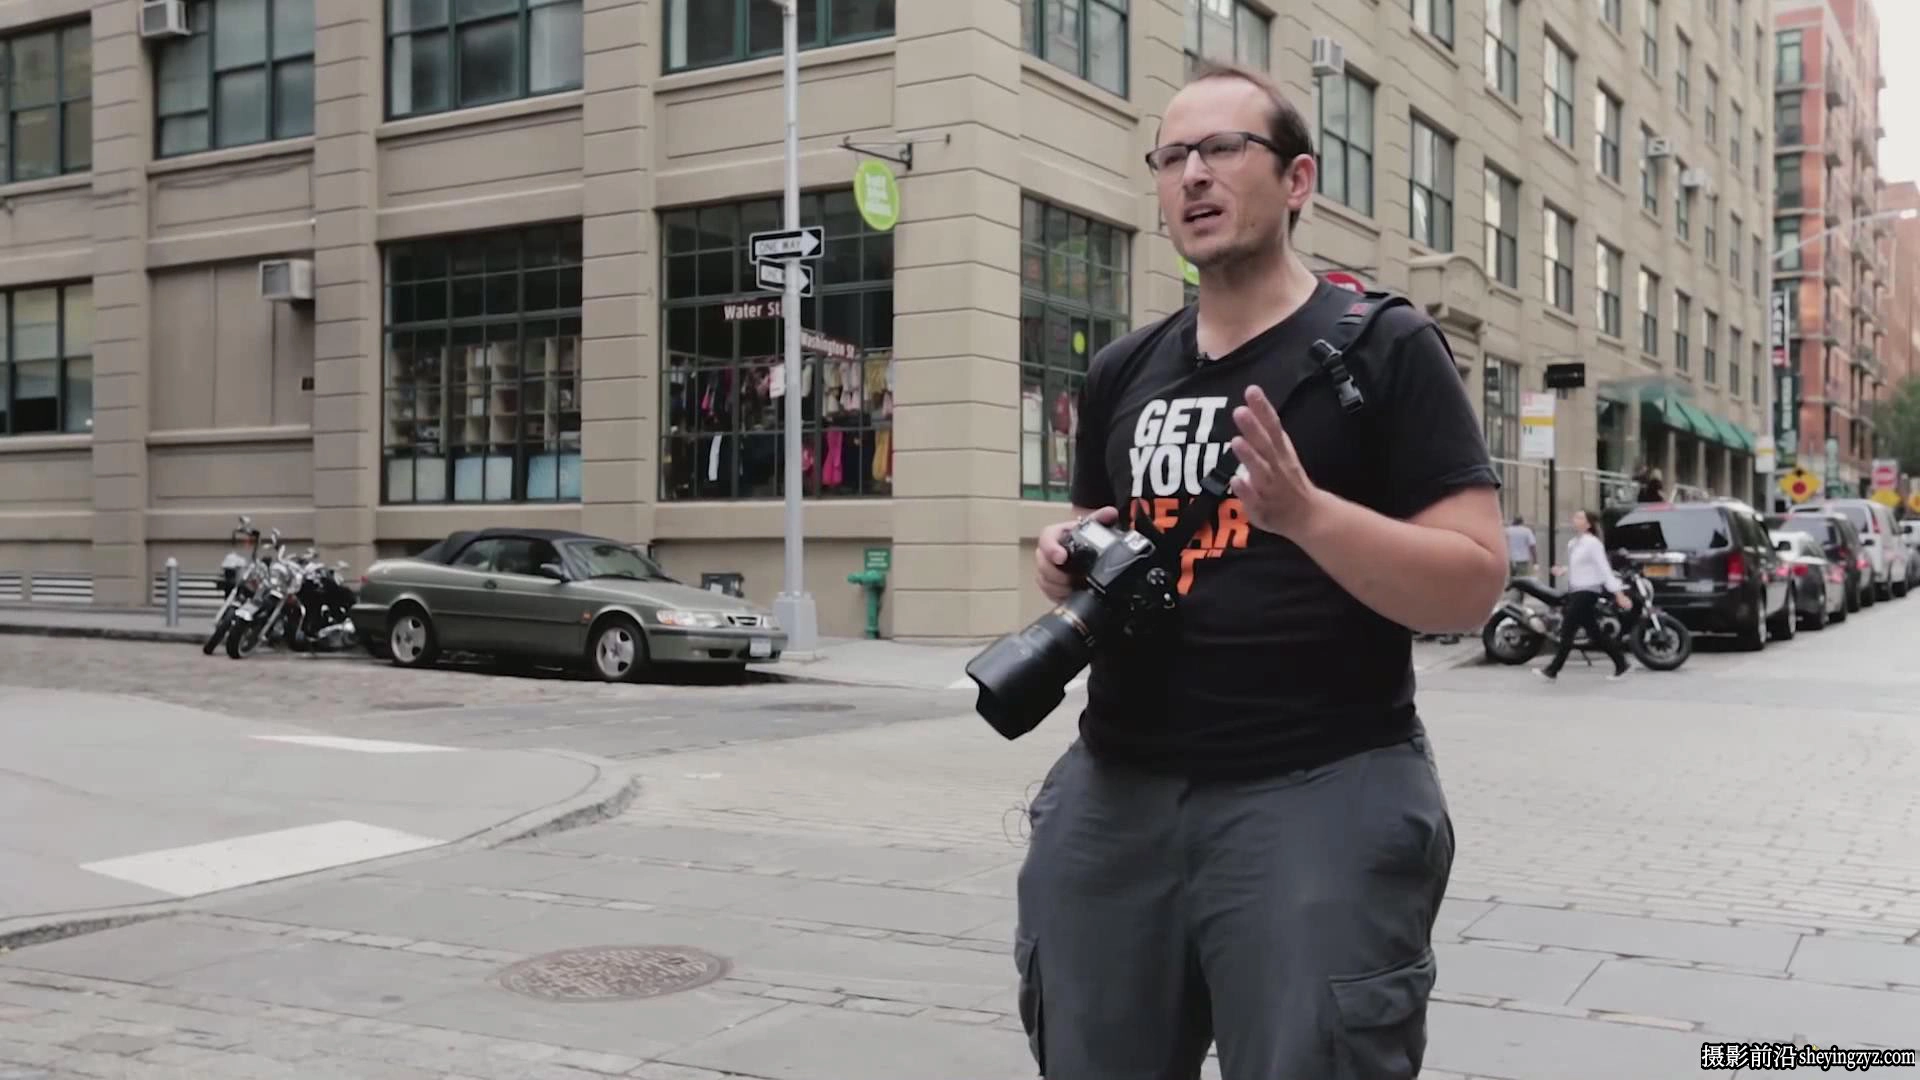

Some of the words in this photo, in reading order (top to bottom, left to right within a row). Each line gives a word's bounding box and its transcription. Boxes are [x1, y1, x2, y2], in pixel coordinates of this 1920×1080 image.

[724, 303, 763, 320] Water
[767, 301, 780, 317] St
[800, 332, 845, 357] Washington
[1134, 396, 1228, 447] GET
